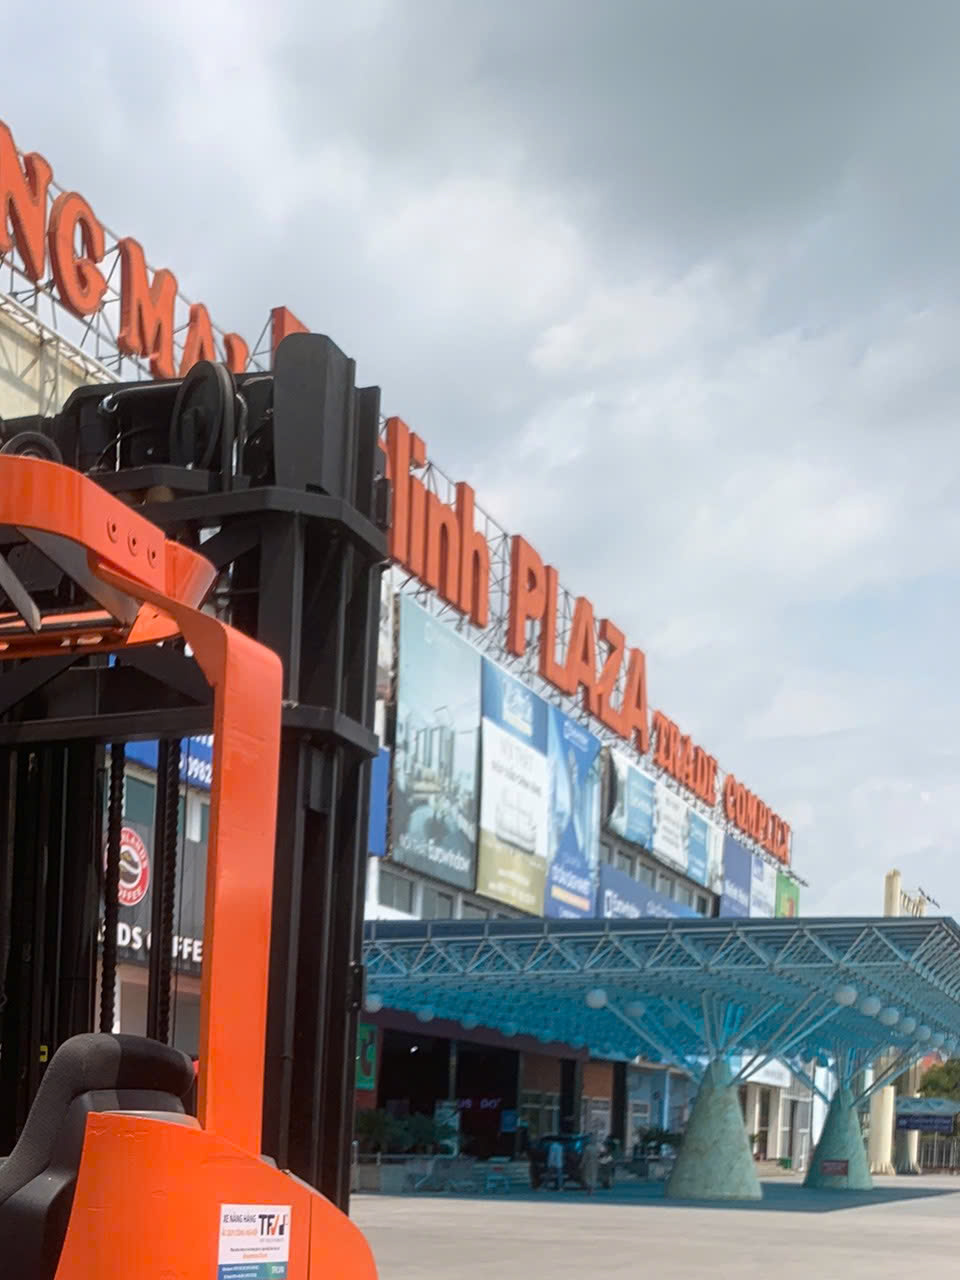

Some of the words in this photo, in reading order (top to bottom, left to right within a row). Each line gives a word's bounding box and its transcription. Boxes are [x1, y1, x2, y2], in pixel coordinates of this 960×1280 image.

[506, 534, 649, 756] PLAZA
[652, 709, 718, 808] TRADE
[723, 773, 792, 866] COMPLEX
